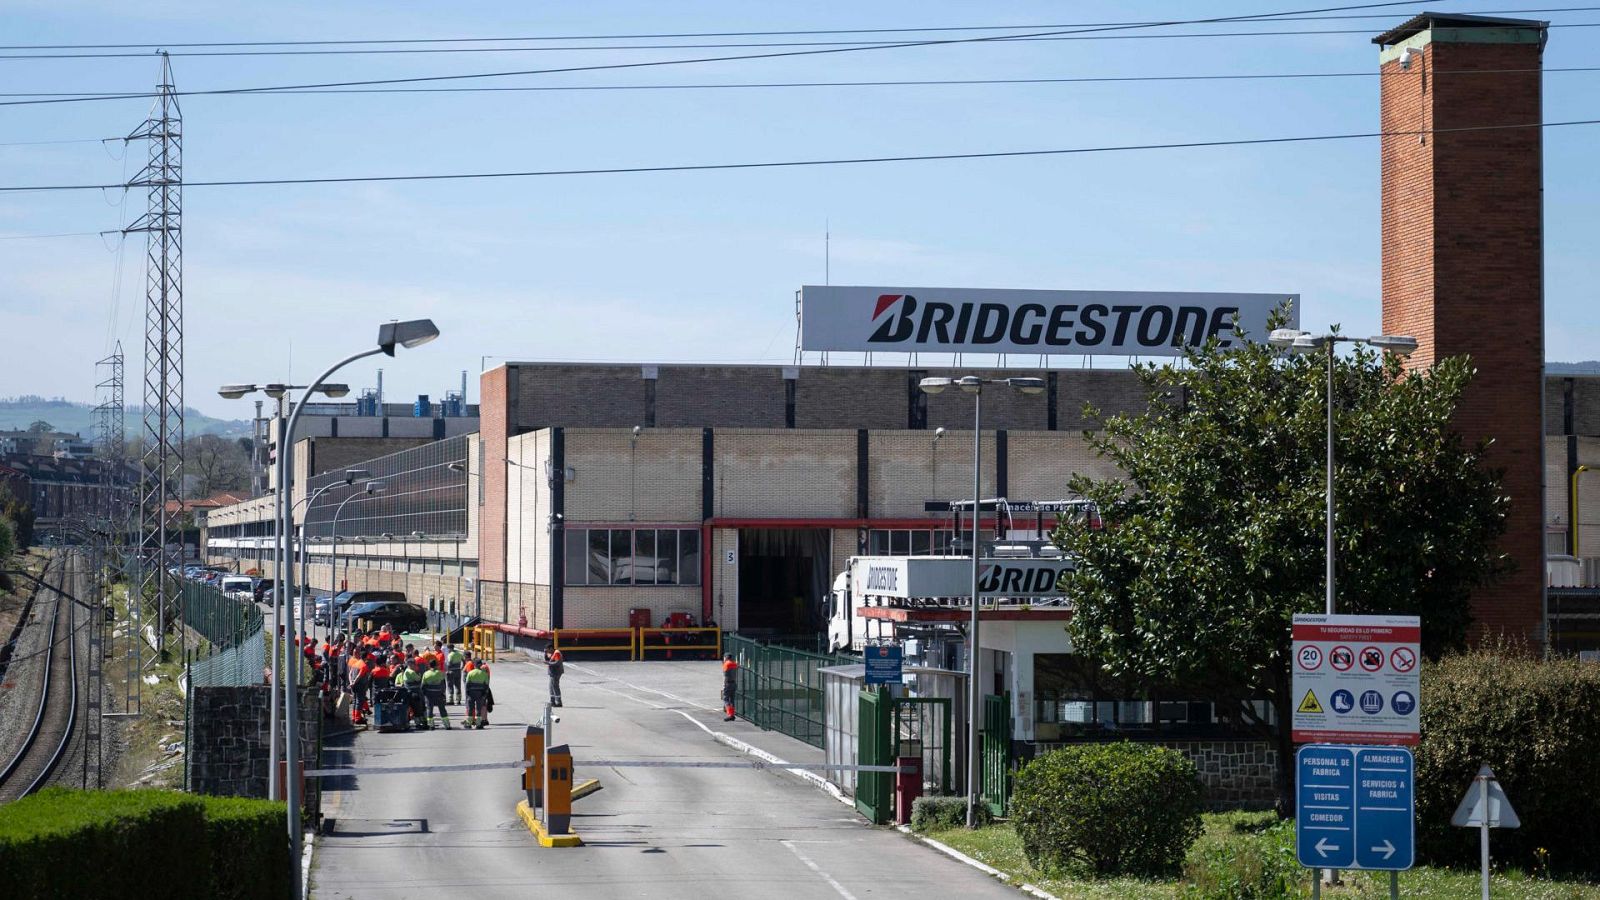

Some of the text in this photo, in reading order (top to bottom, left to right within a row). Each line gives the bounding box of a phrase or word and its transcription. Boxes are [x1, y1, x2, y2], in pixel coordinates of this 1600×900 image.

[867, 294, 1239, 347] BRIDGESTONE
[728, 552, 734, 562] 3
[1303, 650, 1317, 660] 20
[1303, 758, 1350, 767] PERSONAL DE
[1363, 755, 1404, 764] ALMACENES
[1312, 768, 1341, 776] FABRICA
[1362, 780, 1397, 788] SERVICIOS
[1313, 793, 1340, 801] VISITAS
[1369, 790, 1398, 799] FABRICA
[1310, 813, 1343, 822] COMEDOR
